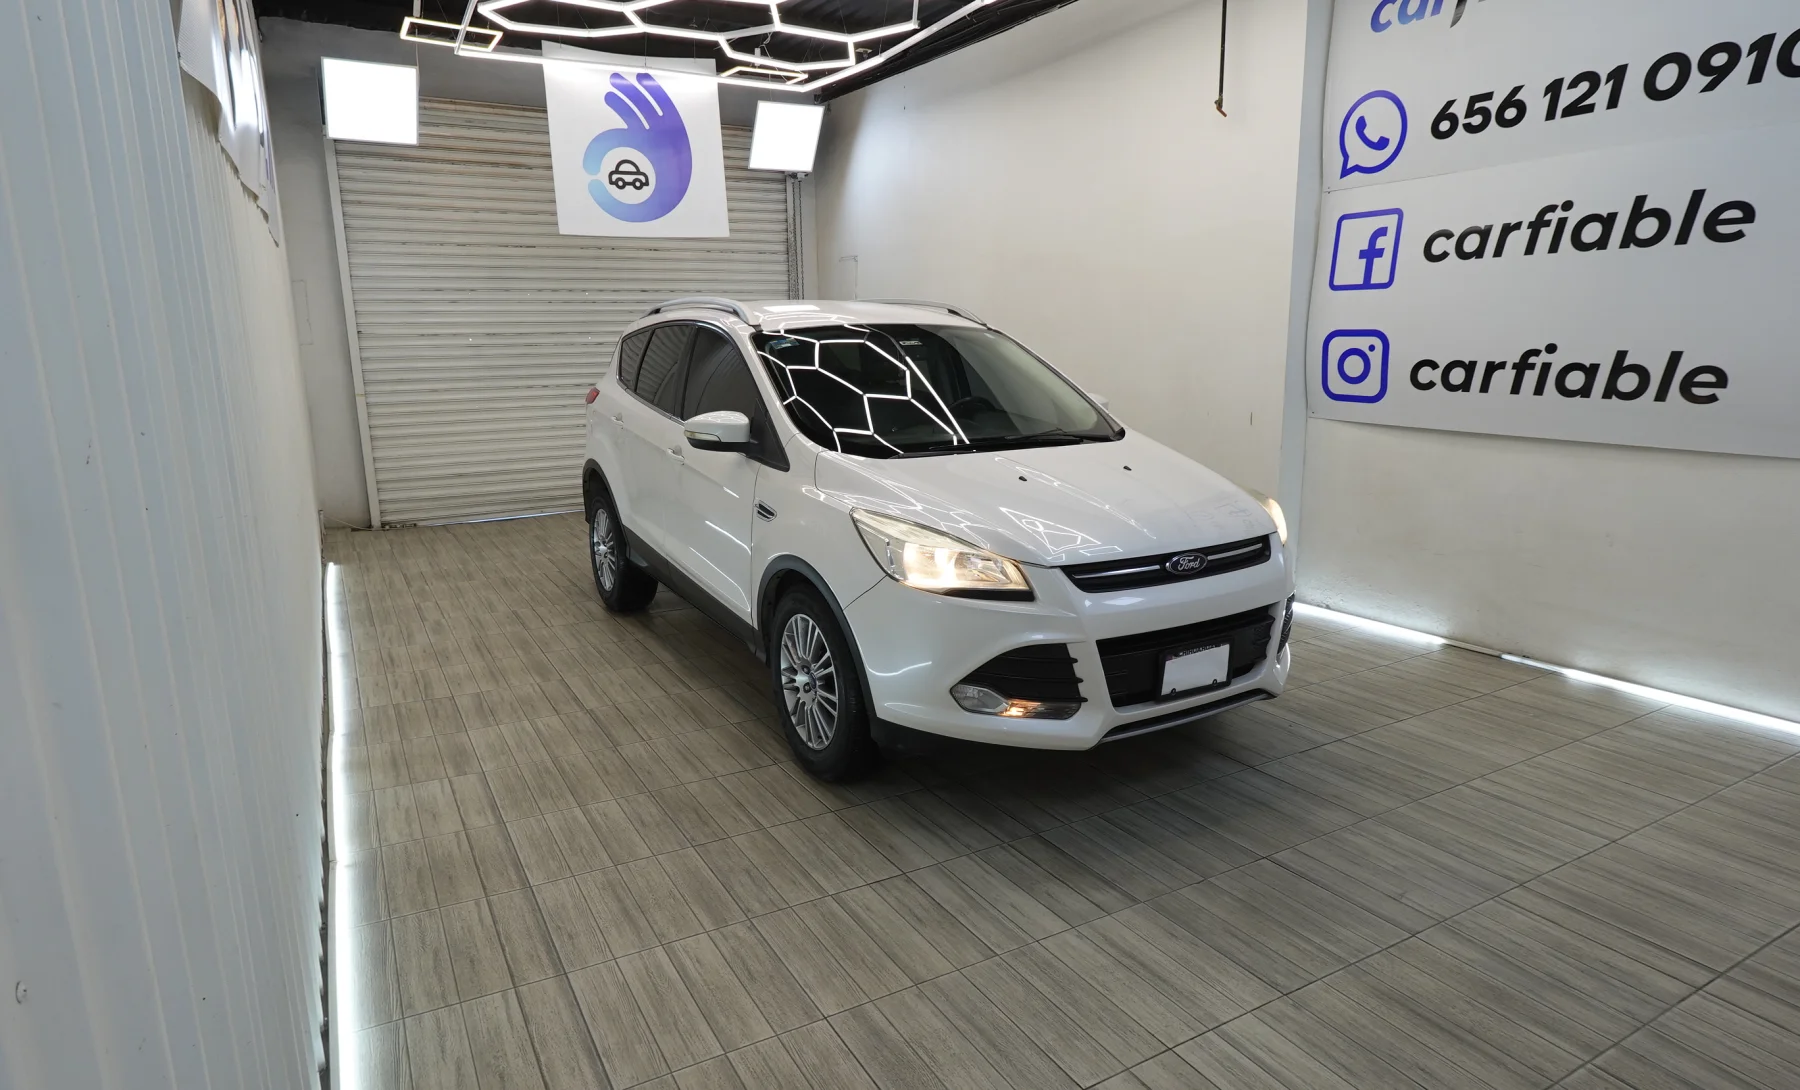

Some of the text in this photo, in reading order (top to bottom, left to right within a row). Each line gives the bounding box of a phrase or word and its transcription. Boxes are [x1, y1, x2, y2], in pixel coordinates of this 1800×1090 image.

[1430, 84, 1527, 140] 656
[1542, 63, 1629, 122] 121
[1423, 188, 1756, 263] carfiable
[1409, 342, 1729, 405] carfiable
[1177, 555, 1201, 571] Ford
